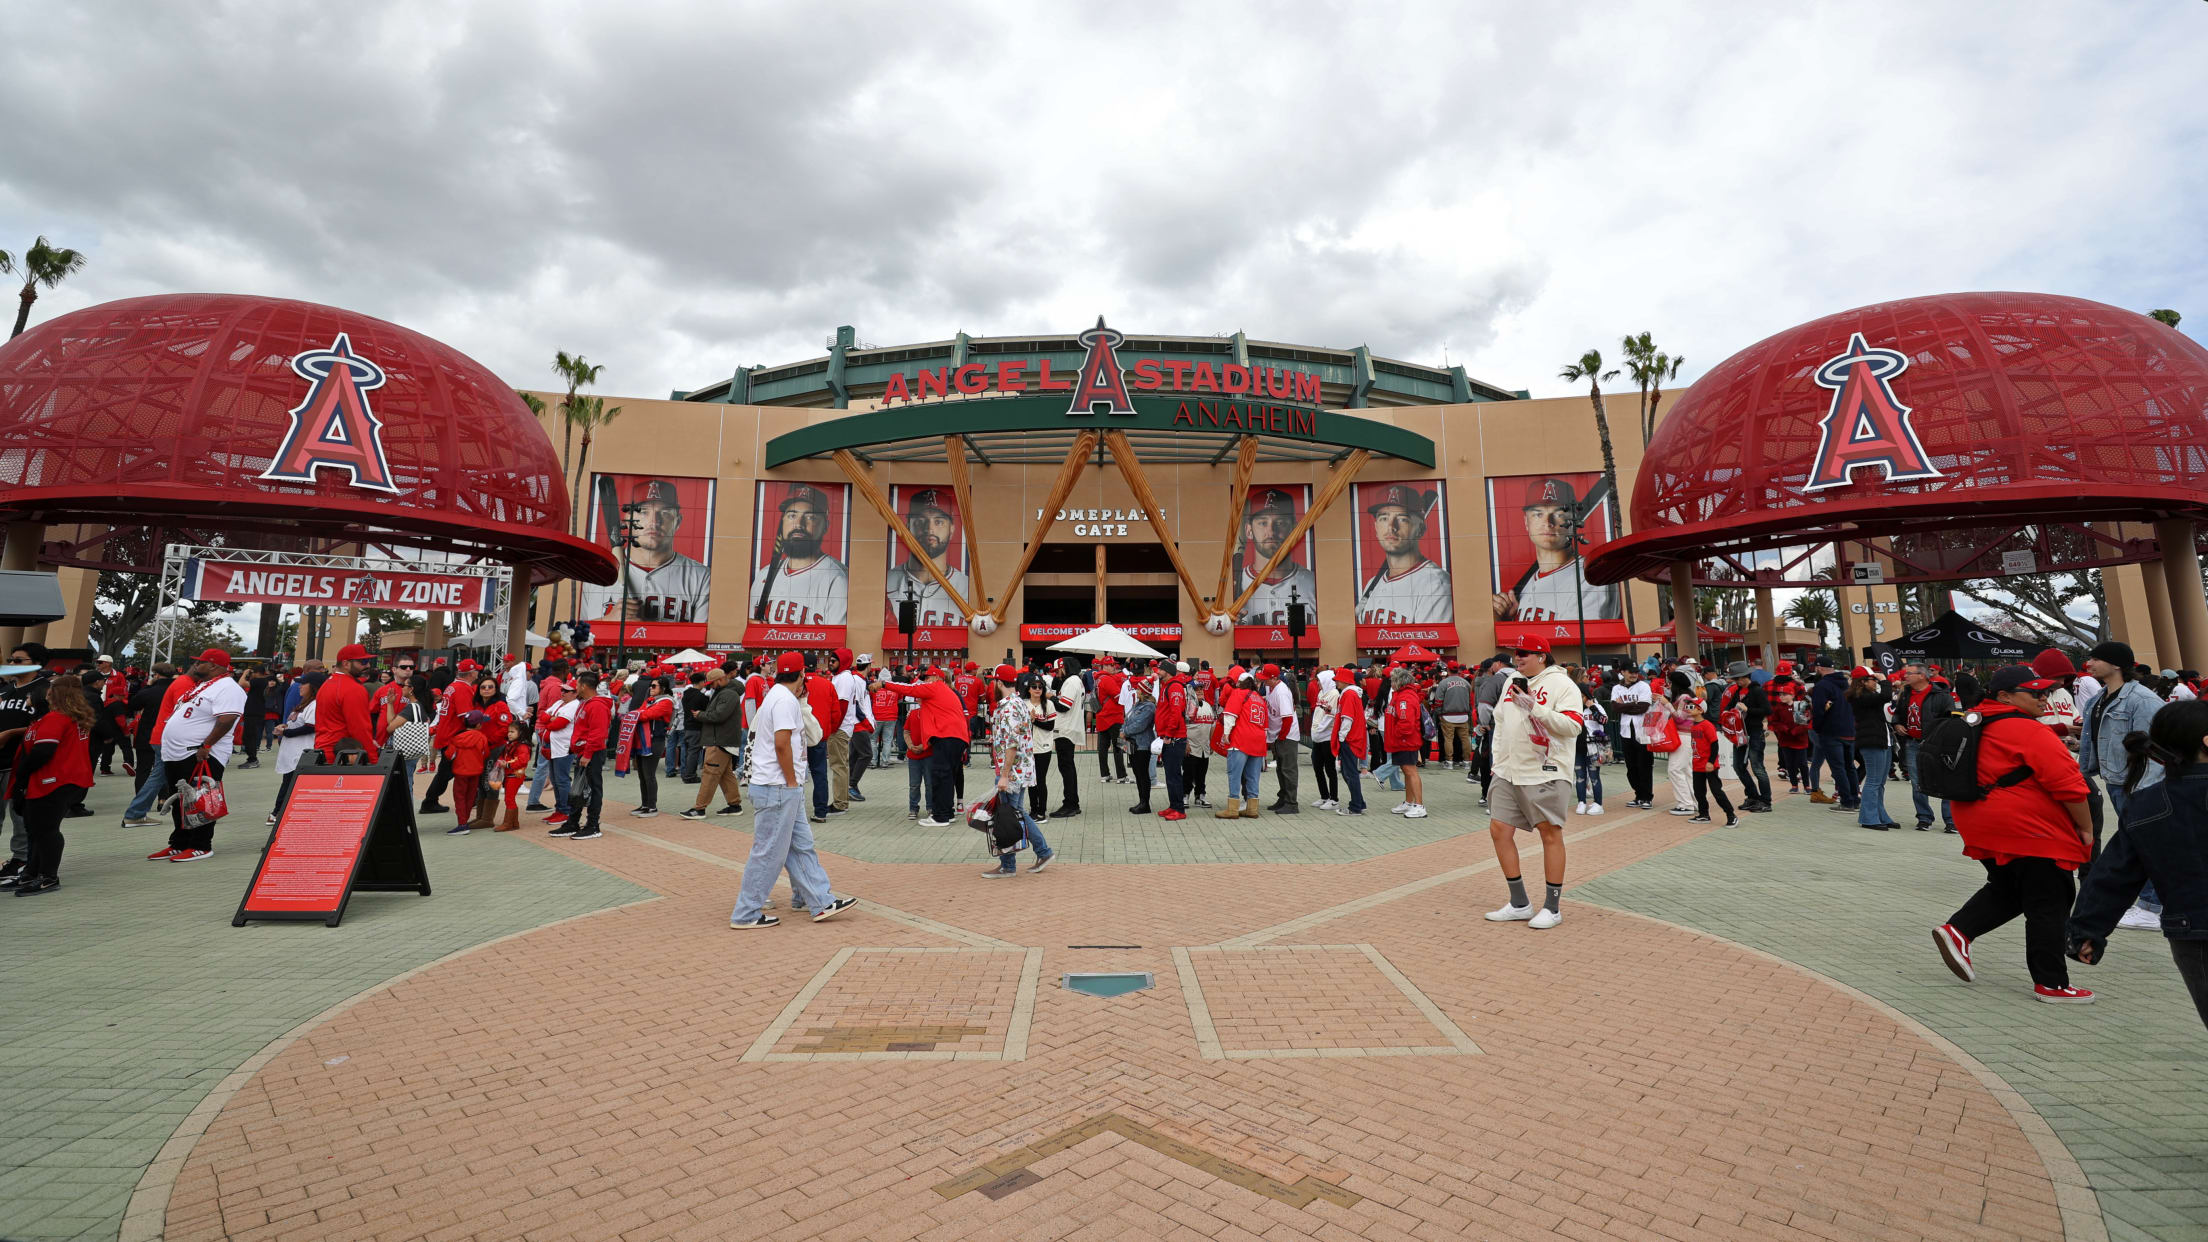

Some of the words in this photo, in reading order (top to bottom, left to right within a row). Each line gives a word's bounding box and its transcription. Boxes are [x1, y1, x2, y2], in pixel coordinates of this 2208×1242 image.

[881, 358, 1071, 405] ANGEL
[1133, 358, 1322, 405] STADIUM
[258, 331, 401, 494] A
[1173, 400, 1317, 437] ANAHEIM
[1800, 331, 1944, 492] A
[1074, 524, 1128, 537] GATE
[225, 570, 335, 599] ANGELS
[342, 573, 393, 604] FAN
[399, 581, 465, 605] ZONE
[763, 628, 826, 641] ANGELS
[1029, 627, 1073, 636] WELCOME
[1075, 627, 1087, 636] TO
[1119, 627, 1137, 636] OME
[1140, 627, 1182, 636] OPENER
[1377, 628, 1440, 641] ANGELS
[876, 691, 897, 707] 27
[183, 706, 194, 719] 6
